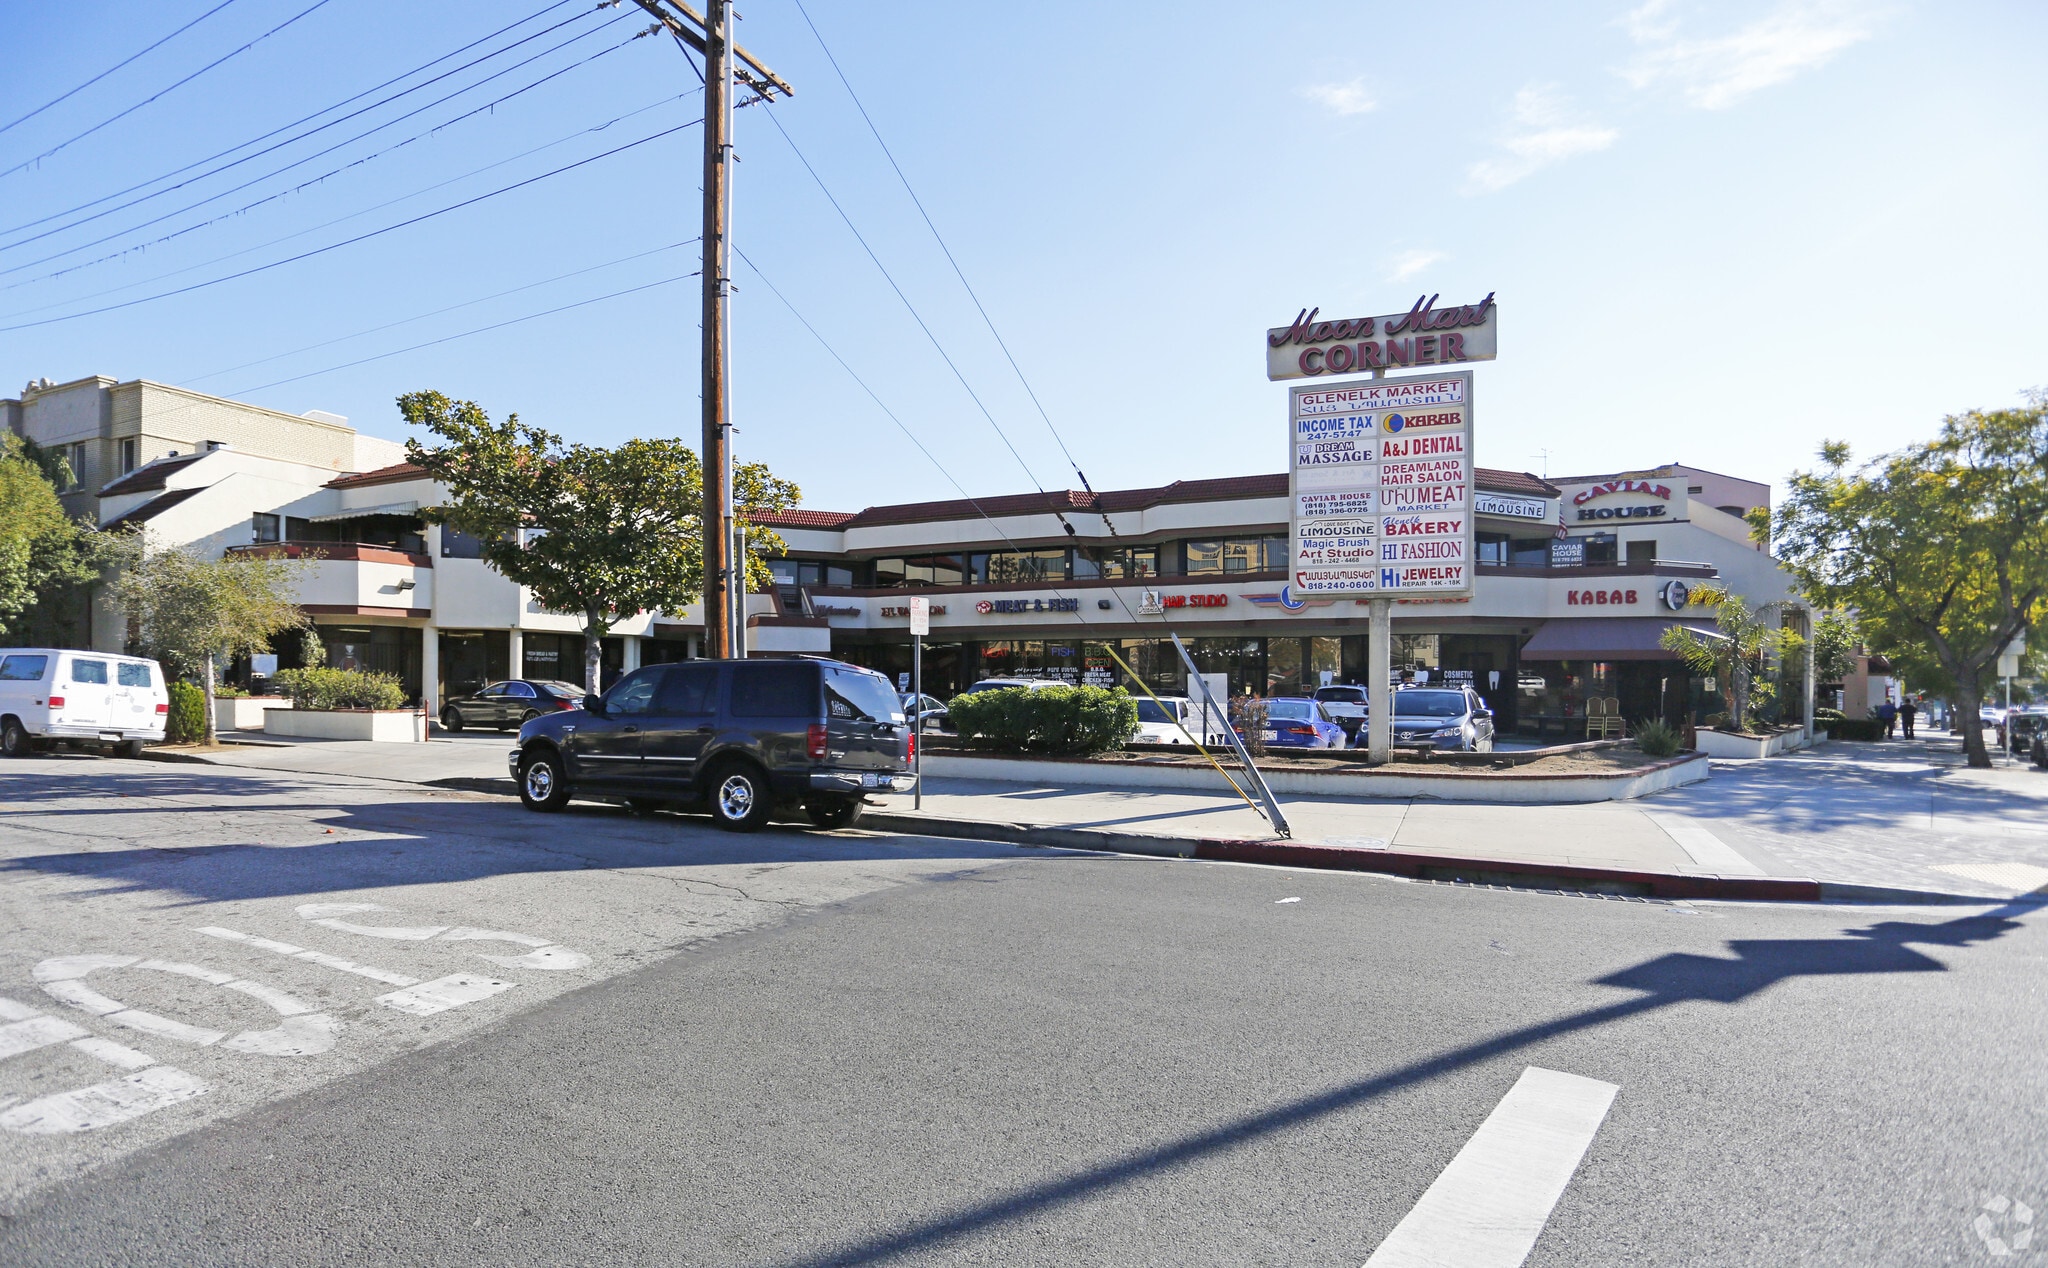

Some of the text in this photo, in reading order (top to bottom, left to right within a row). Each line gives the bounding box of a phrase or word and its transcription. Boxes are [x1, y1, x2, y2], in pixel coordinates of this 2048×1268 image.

[1269, 292, 1495, 347] Moon Mart
[1299, 333, 1467, 375] CORNER
[1303, 382, 1459, 405] GLENELK MARKET
[1298, 416, 1372, 433] INCOME TAX
[1405, 413, 1461, 428] KABAB
[1307, 430, 1361, 440] 247-5747
[1316, 442, 1354, 452] DREAM
[1413, 436, 1463, 455] DENTAL
[1299, 451, 1372, 465] MASSAGE
[1383, 461, 1459, 474] DREAMLAND
[1381, 471, 1462, 485] HAIR SALON
[1417, 486, 1465, 503] MEAT
[1573, 481, 1671, 505] CAVIAR
[1475, 502, 1542, 516] LIMOUSINE
[1577, 505, 1666, 520] HOUSE
[1383, 516, 1420, 528] Glenelk
[1386, 521, 1462, 536] BAKERY
[1300, 526, 1374, 536] LIMOUSINE
[1303, 538, 1369, 549] Magic Brush
[1300, 548, 1374, 558] Art Studio
[1382, 542, 1462, 560] HI FASHION
[1381, 567, 1462, 588] Hi JEWELRY
[1308, 581, 1374, 589] 818-240-0600
[1162, 594, 1228, 608] HAIR STUDIO
[1568, 590, 1637, 605] KABAB
[995, 598, 1077, 613] MEAT & FISH
[982, 648, 1008, 658] MEAT
[1051, 647, 1075, 657] FISH
